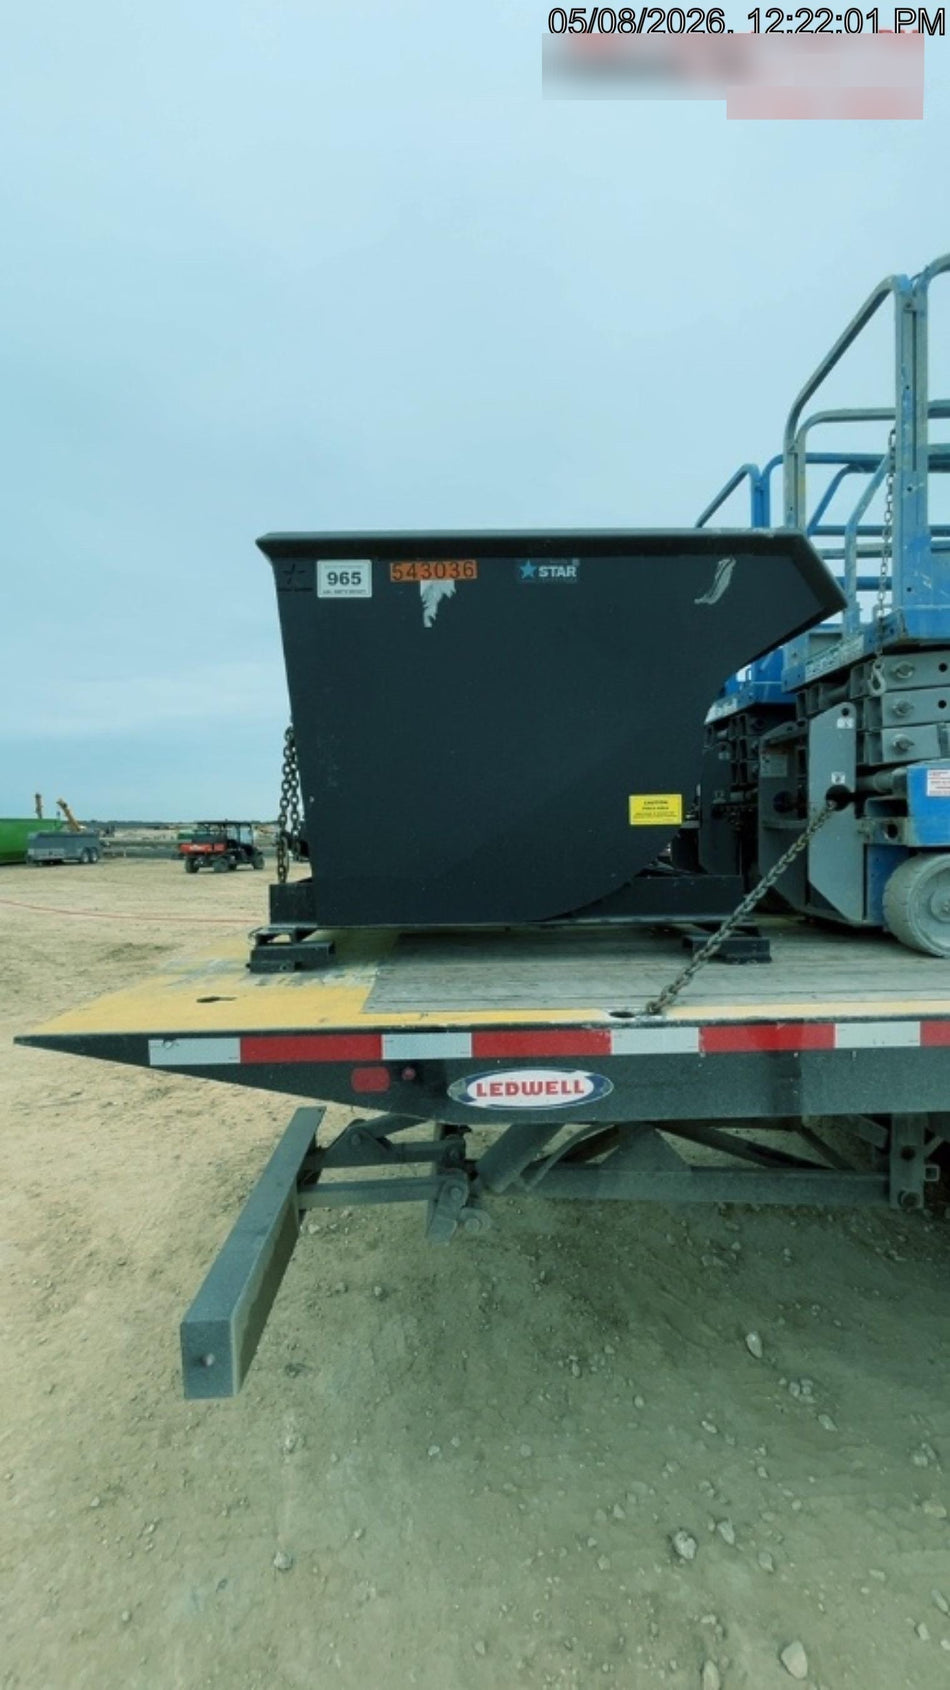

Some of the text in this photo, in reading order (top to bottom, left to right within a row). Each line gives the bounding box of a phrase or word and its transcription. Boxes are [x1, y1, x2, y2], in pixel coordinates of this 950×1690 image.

[327, 571, 362, 586] 965
[391, 560, 475, 581] 543036
[538, 565, 577, 577] STAR
[476, 1079, 585, 1098] LEDWELL
